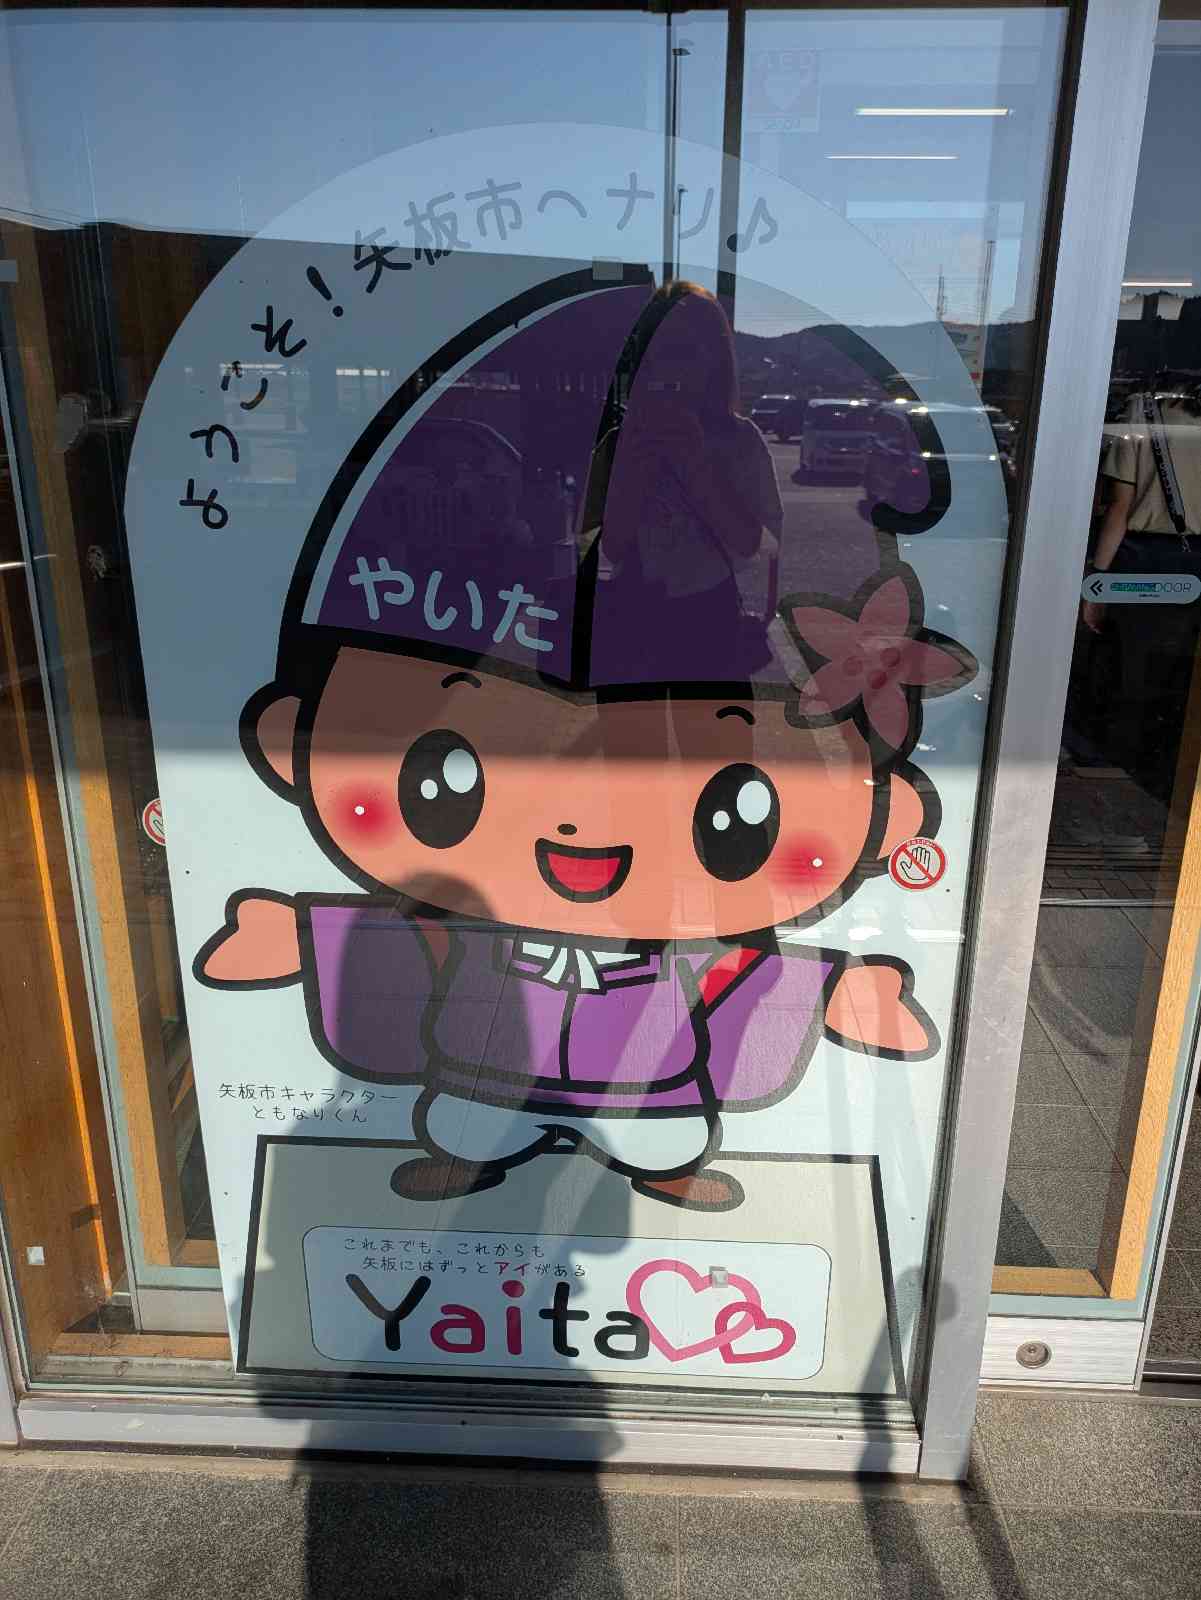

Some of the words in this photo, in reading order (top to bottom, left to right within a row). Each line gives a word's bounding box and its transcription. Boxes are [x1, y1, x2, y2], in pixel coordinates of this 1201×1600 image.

[348, 556, 559, 652] やいた
[218, 1083, 401, 1104] 矢板市キャラクター
[253, 1105, 368, 1123] ともなりくん
[345, 1273, 651, 1361] Yaita
